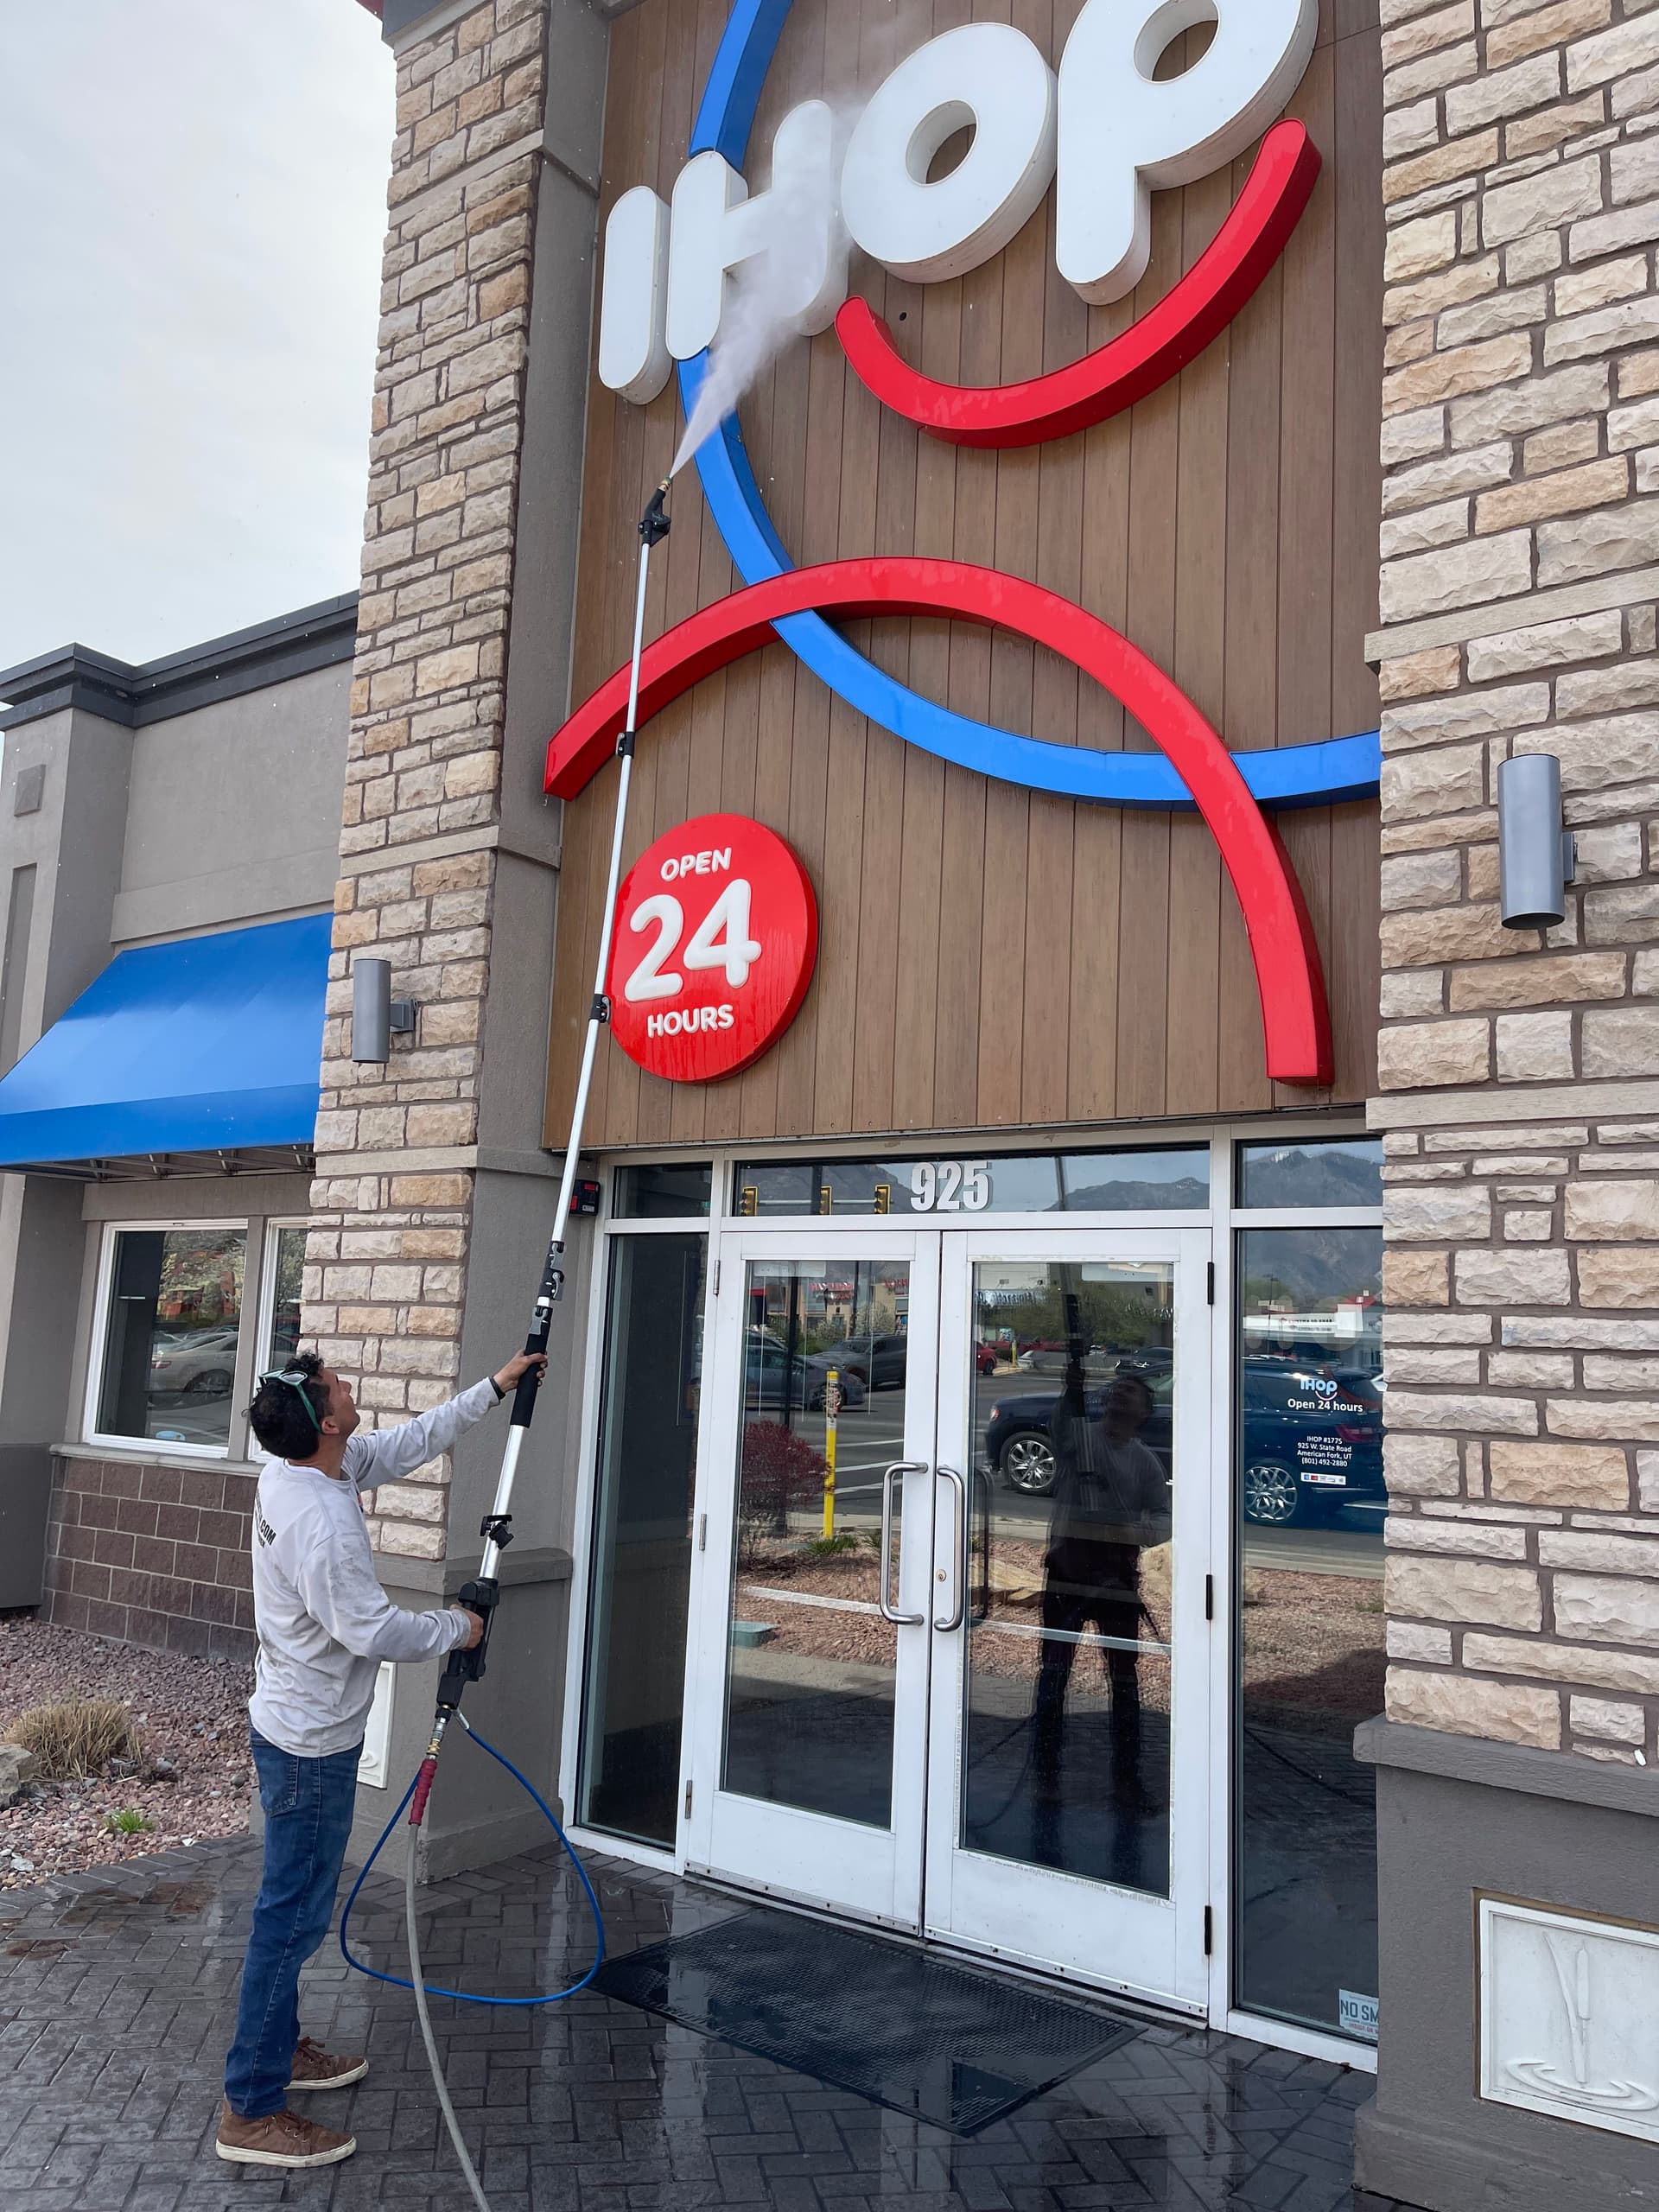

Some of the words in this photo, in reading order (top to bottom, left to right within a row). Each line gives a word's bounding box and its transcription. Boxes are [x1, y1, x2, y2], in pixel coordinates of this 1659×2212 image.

[660, 847, 732, 881] OPEN
[624, 878, 762, 1002] 24
[647, 1004, 734, 1039] HOURS
[910, 1160, 990, 1211] 925
[1287, 1398, 1315, 1410] Open
[1318, 1400, 1331, 1410] 24
[1333, 1401, 1363, 1412] hours
[1297, 1449, 1326, 1458] American
[1301, 1457, 1318, 1465] (801)
[1340, 1999, 1358, 2018] NO
